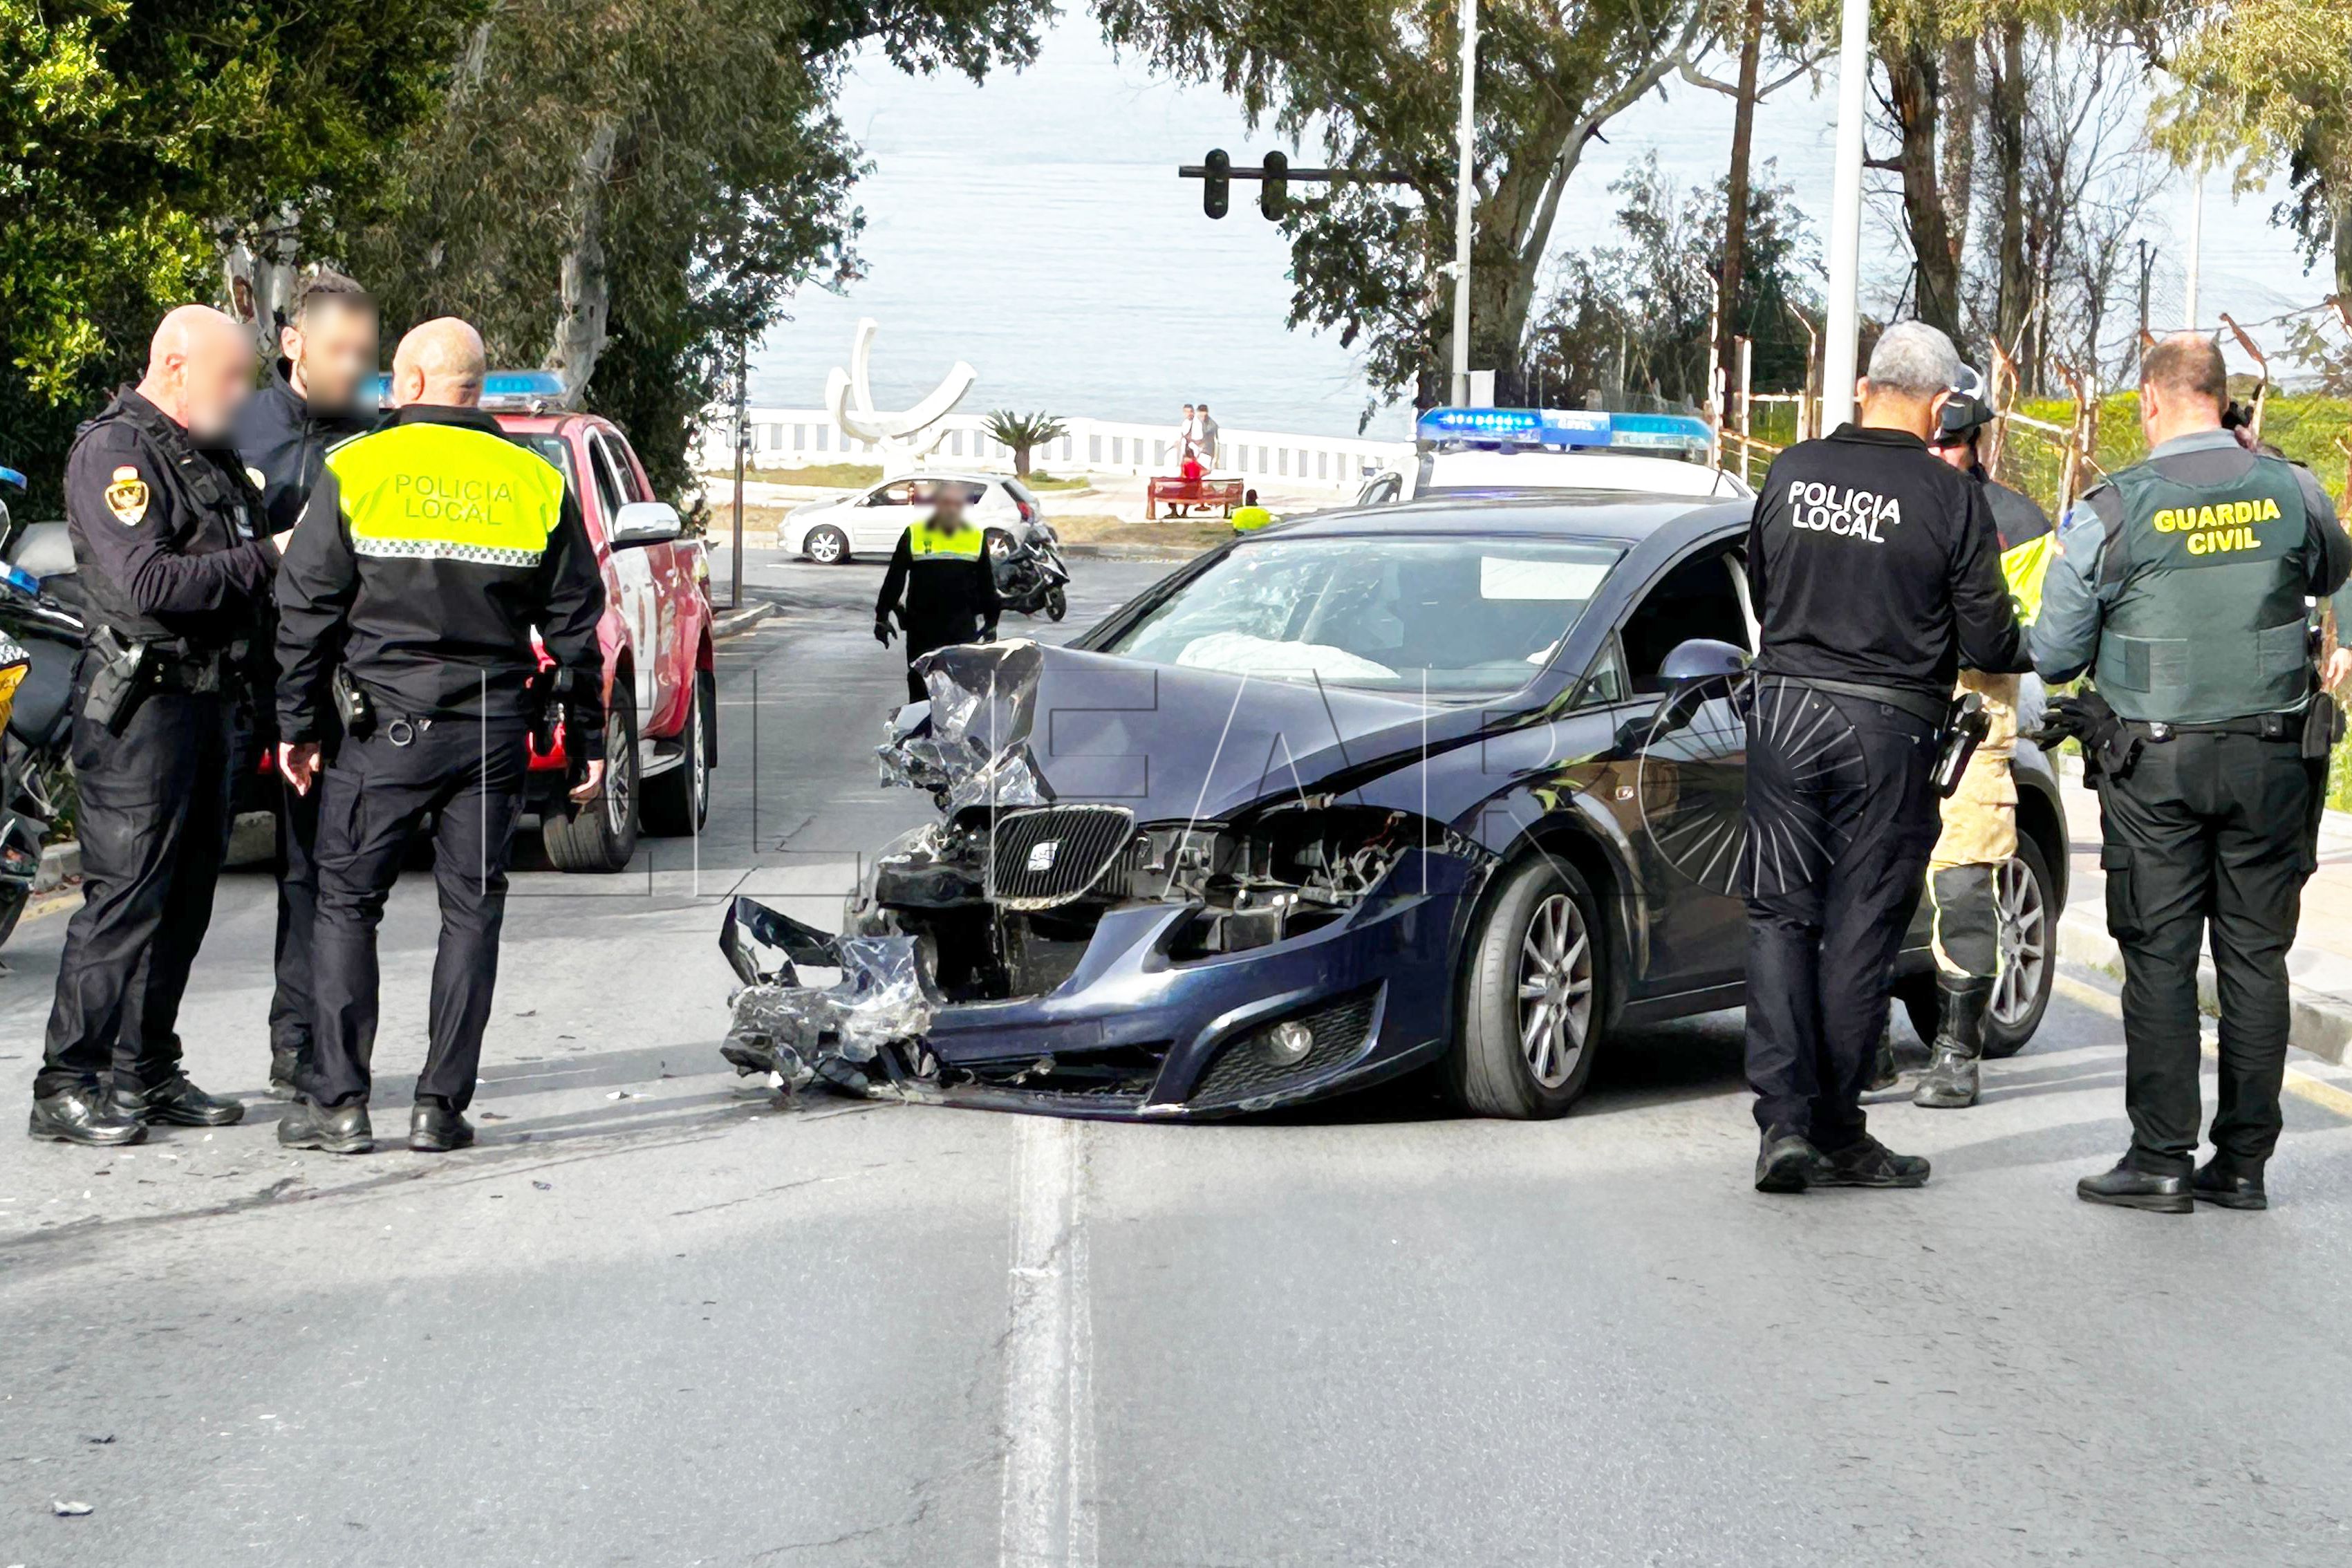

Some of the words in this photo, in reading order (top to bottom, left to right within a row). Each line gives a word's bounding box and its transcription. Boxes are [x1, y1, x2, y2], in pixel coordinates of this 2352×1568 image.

[396, 474, 512, 503] POLICIA
[1788, 480, 1901, 525] POLICIA
[406, 498, 502, 525] LOCAL
[1792, 503, 1885, 543] LOCAL
[2153, 498, 2281, 533] GUARDIA
[2187, 527, 2261, 555] CIVIL
